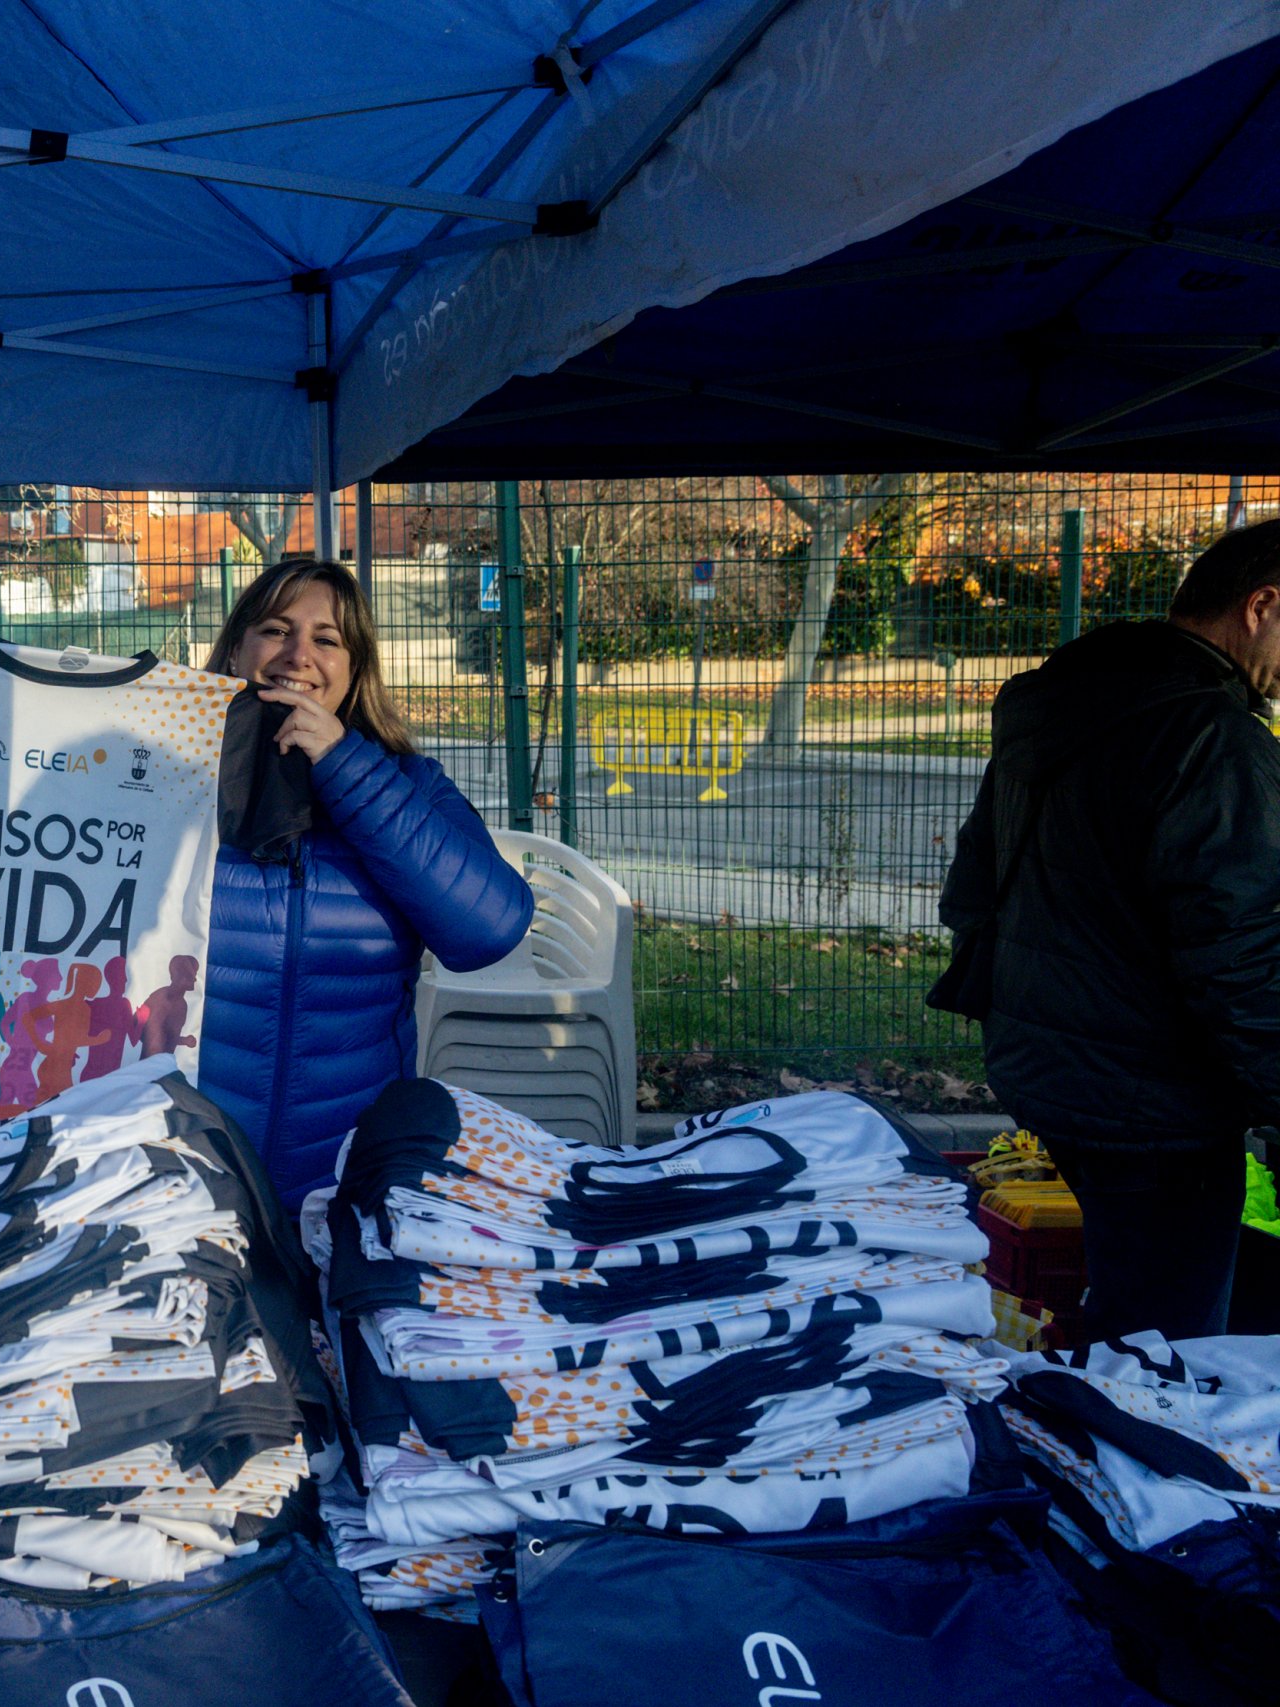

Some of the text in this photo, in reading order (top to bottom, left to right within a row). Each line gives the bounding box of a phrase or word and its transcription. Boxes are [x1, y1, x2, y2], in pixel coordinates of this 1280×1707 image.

[24, 748, 89, 775] ELEIA
[107, 820, 146, 843] POR
[116, 847, 143, 869] LA
